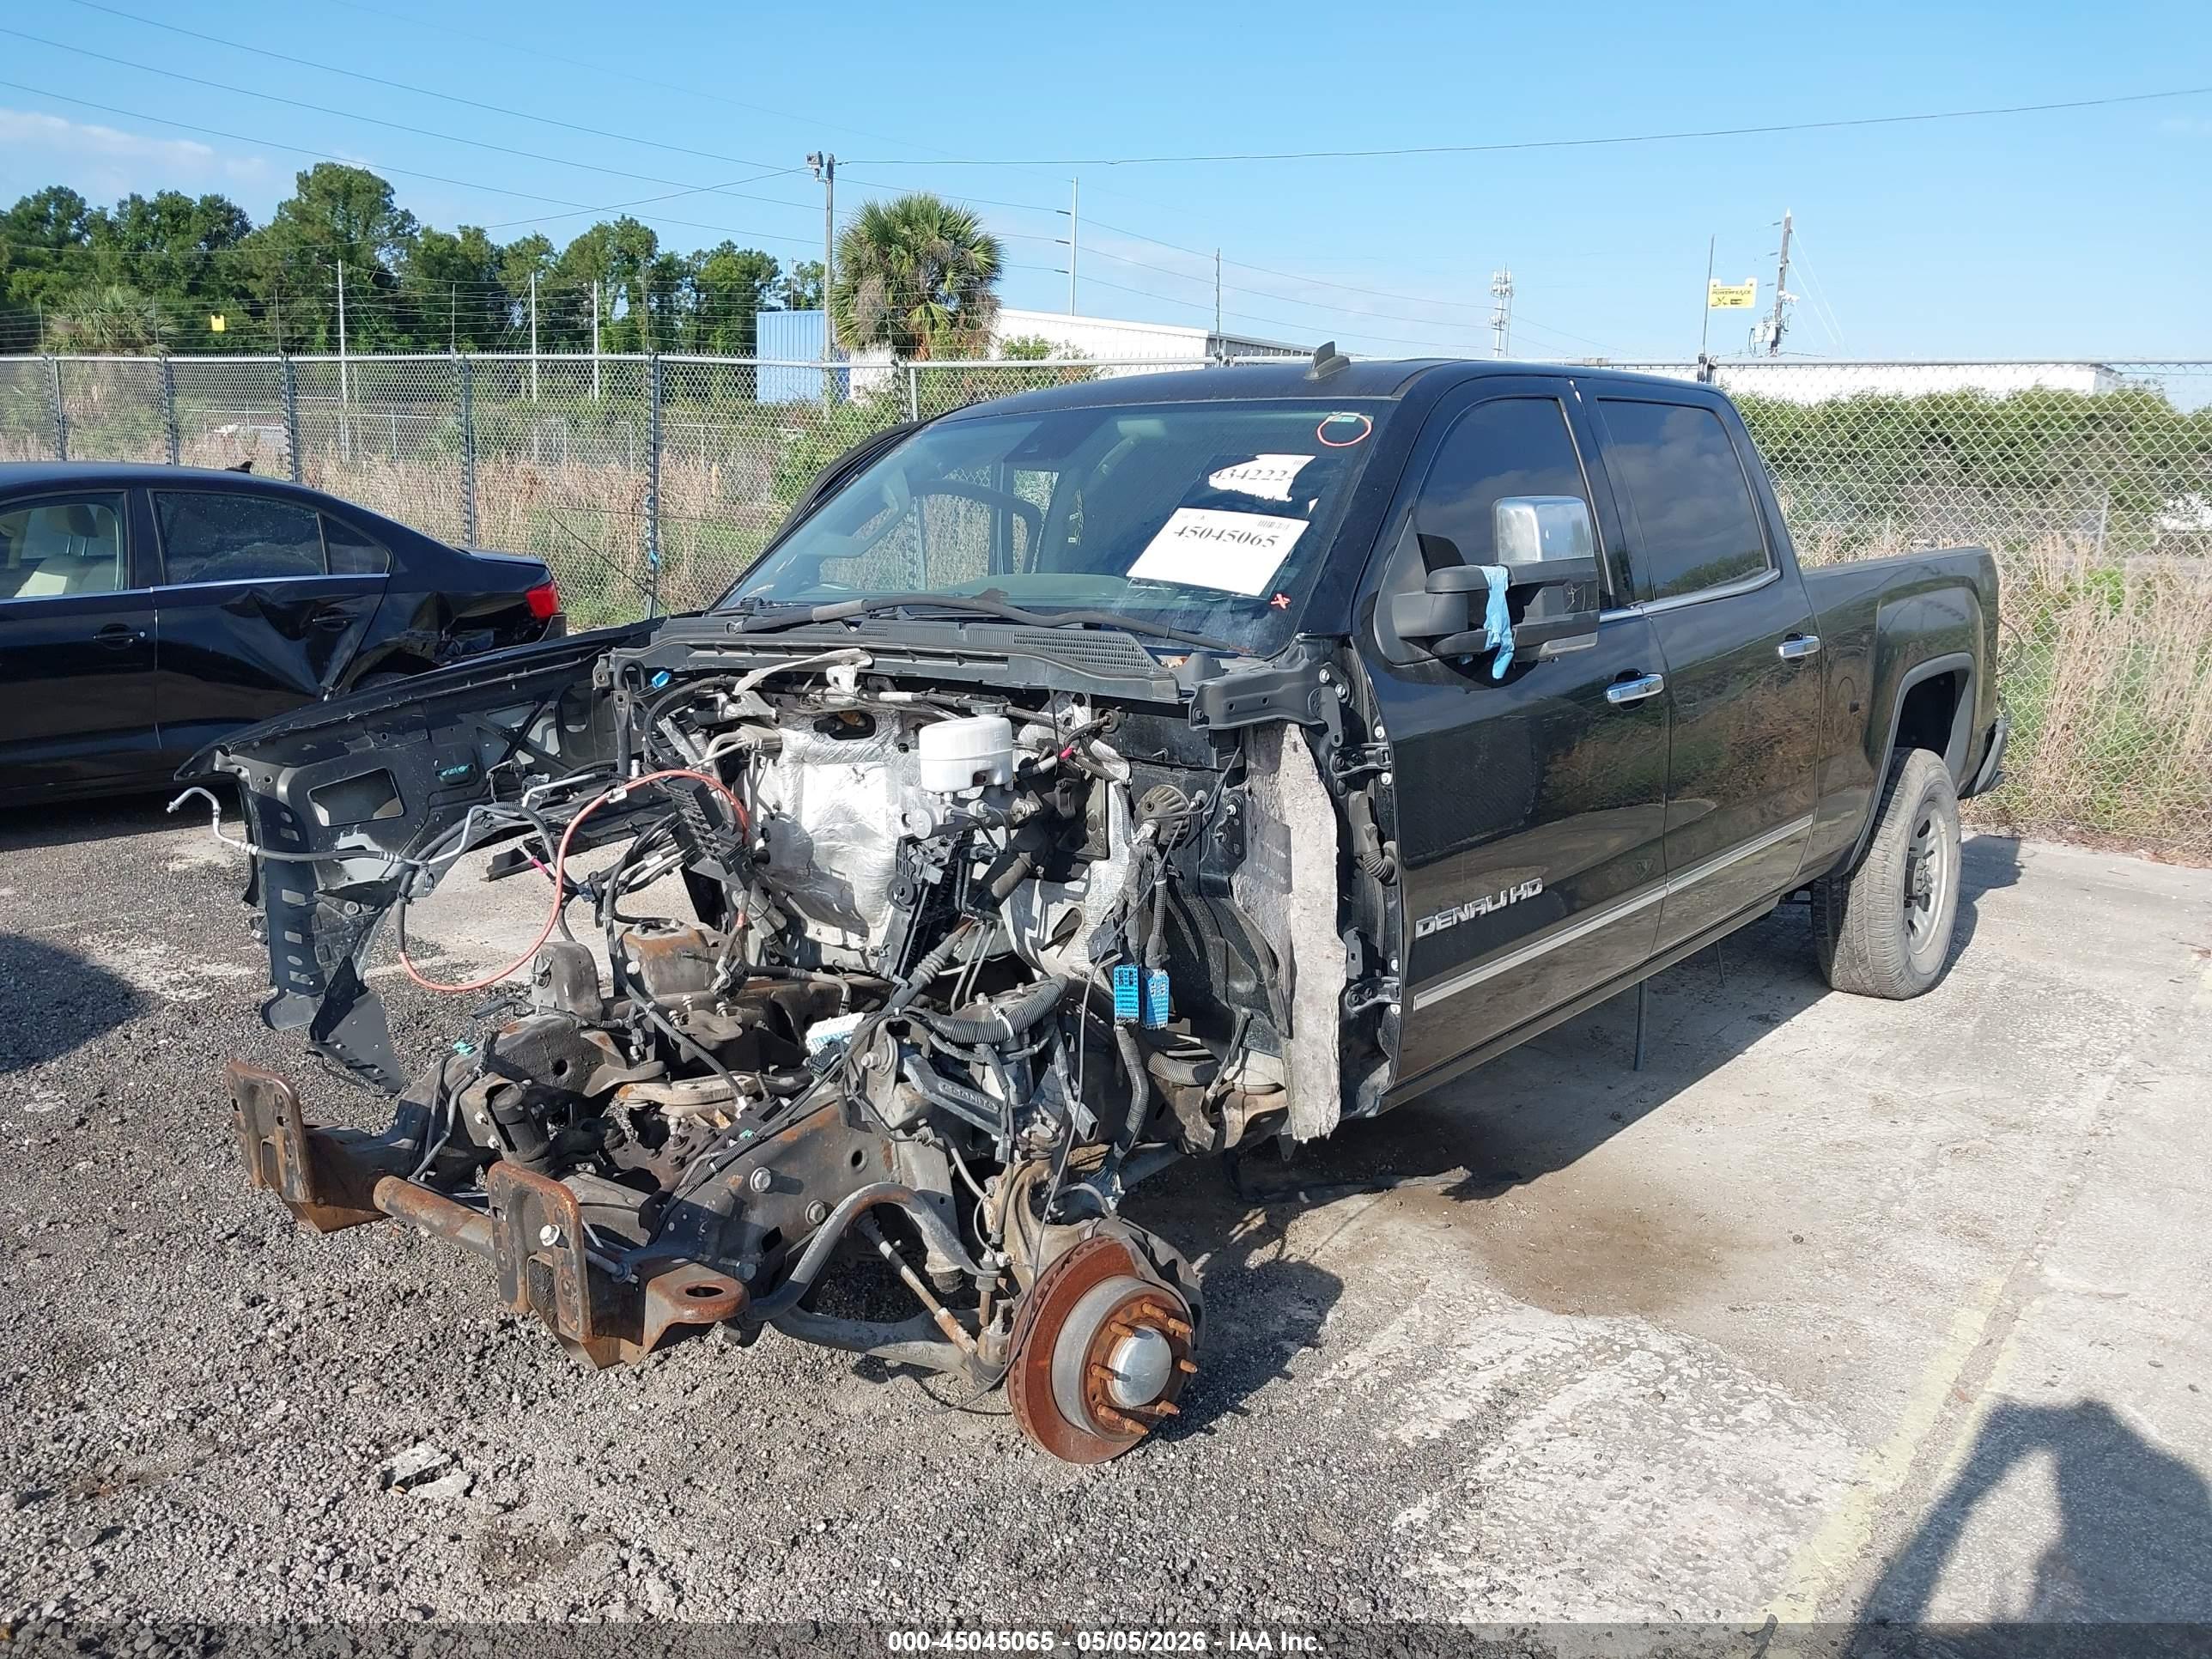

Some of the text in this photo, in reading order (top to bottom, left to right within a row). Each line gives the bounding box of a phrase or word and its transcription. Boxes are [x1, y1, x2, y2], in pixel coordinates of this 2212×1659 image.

[1174, 525, 1279, 547] 45045065
[1415, 877, 1543, 939] DENALI HD
